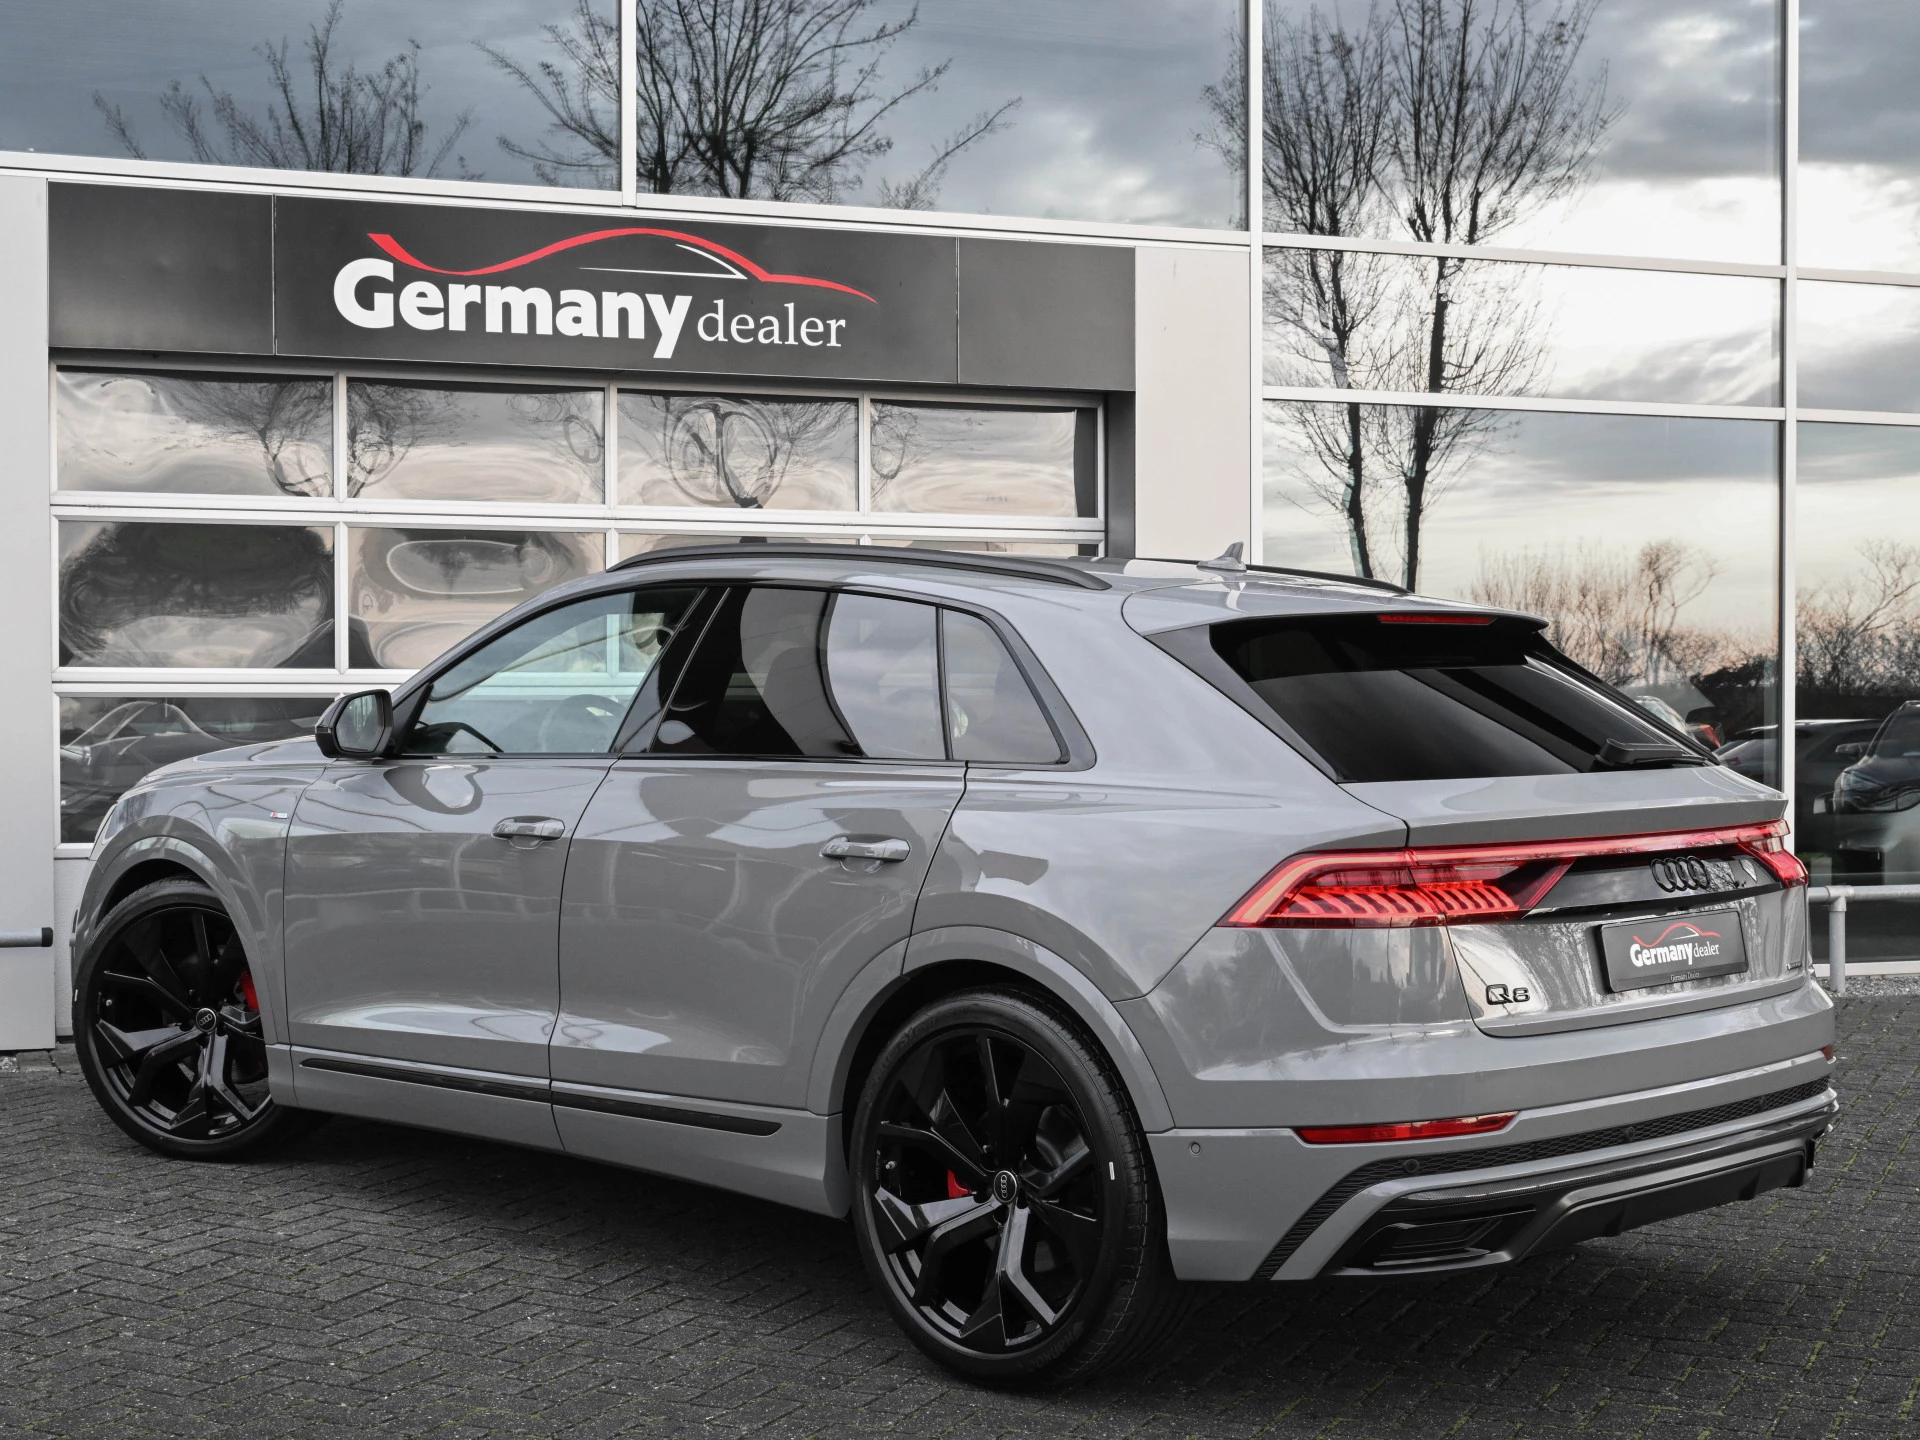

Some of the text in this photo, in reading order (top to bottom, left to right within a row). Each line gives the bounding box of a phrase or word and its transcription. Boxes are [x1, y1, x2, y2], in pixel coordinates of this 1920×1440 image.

[333, 257, 846, 359] Germany dealer
[1629, 940, 1720, 968] Germany dealer
